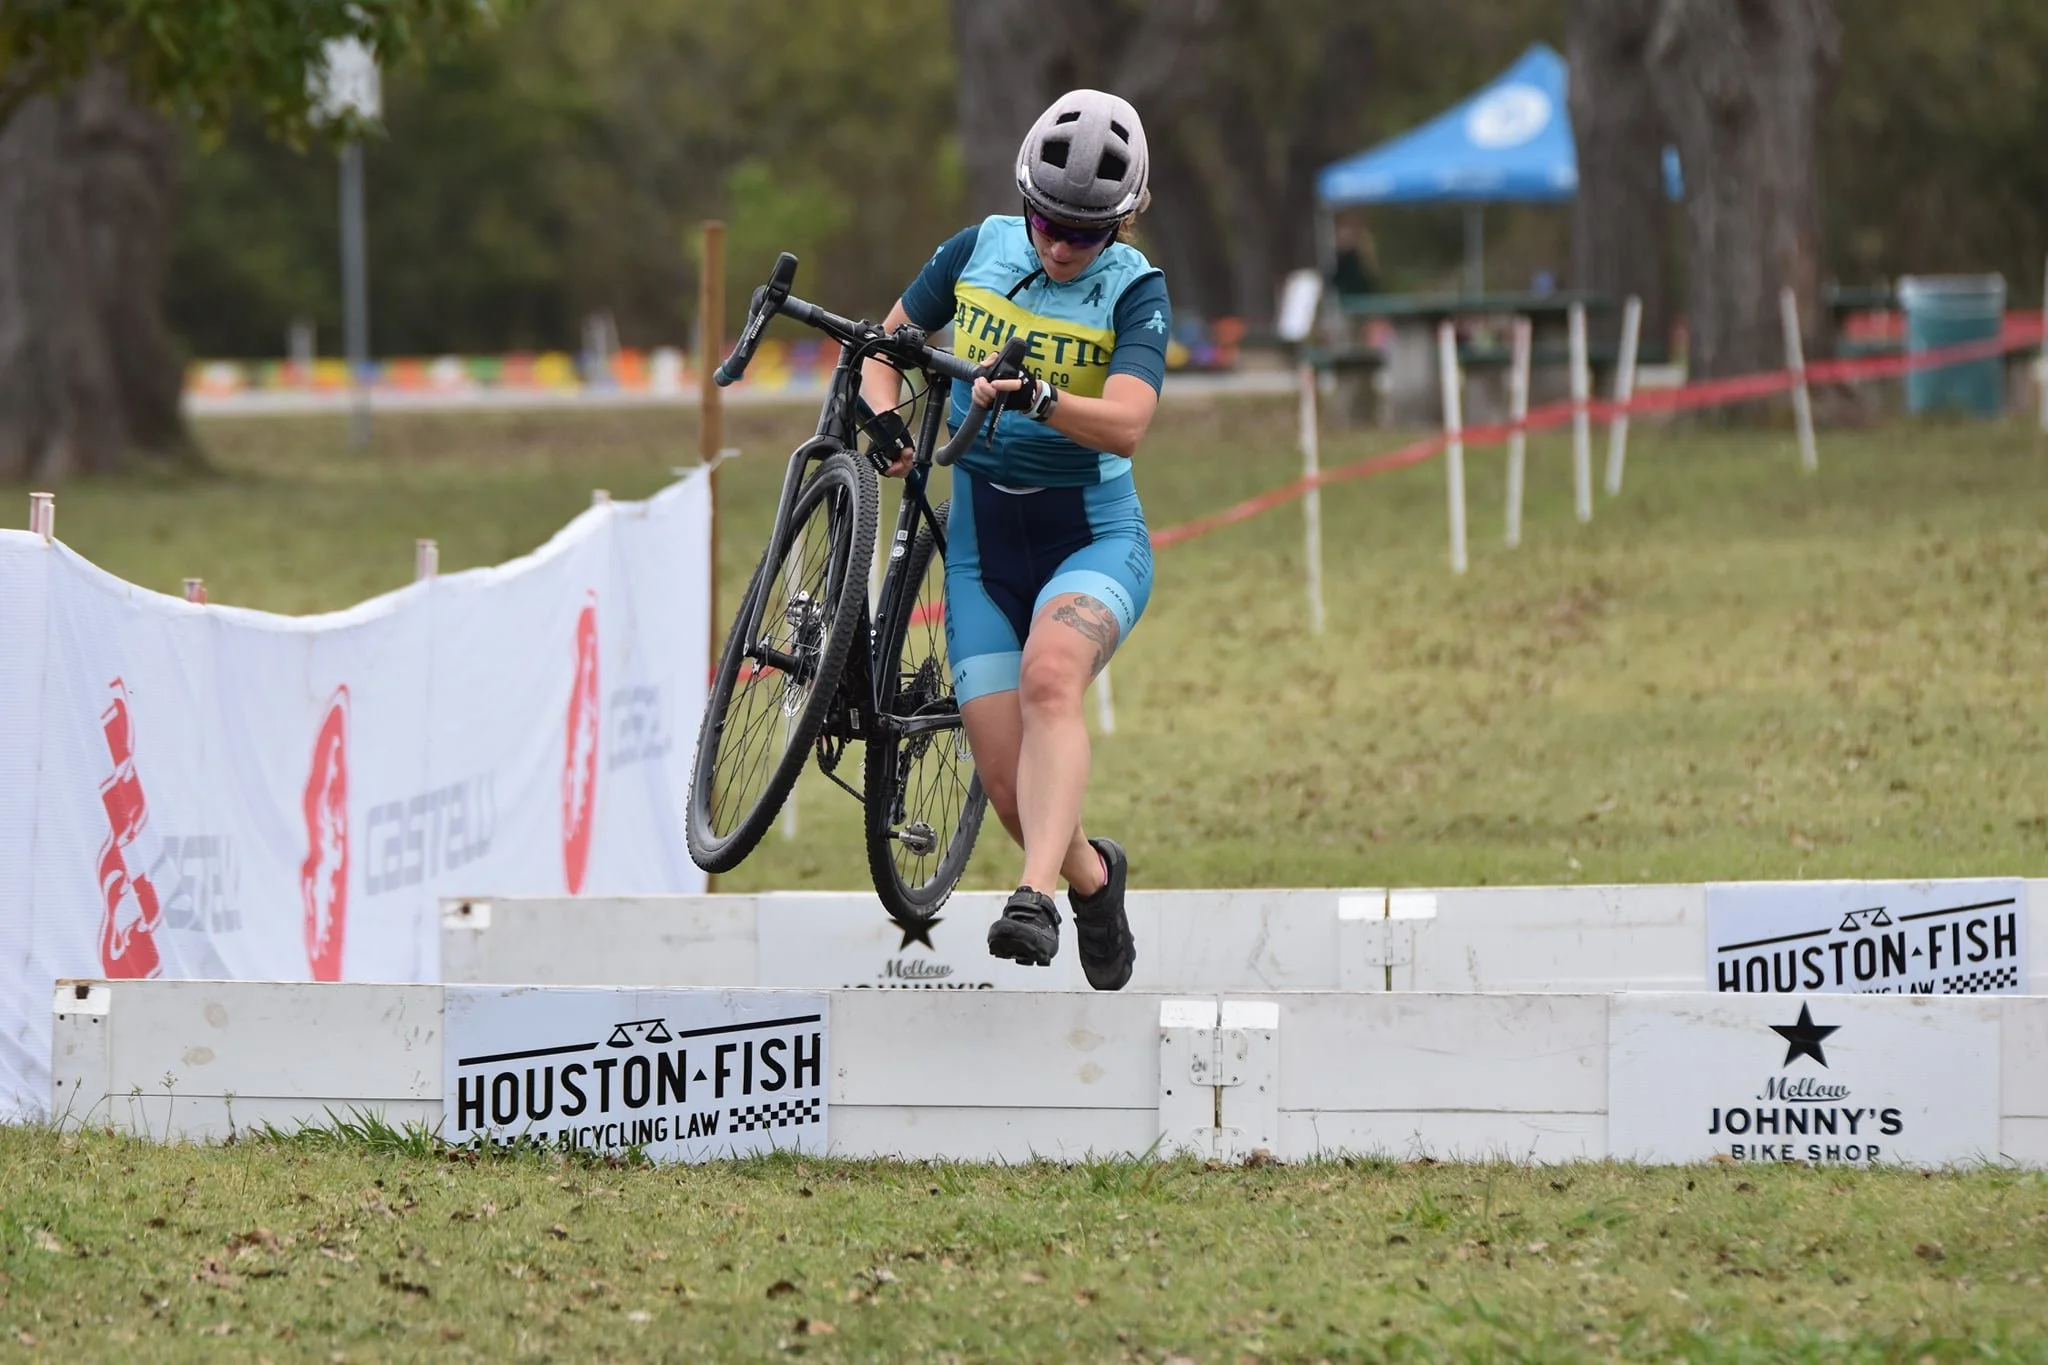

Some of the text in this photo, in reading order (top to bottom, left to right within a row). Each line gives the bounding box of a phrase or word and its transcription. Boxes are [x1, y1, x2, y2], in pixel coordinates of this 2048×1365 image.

[1717, 912, 2017, 993] HOUSTON FISH
[877, 959, 954, 980] Mellow
[457, 1032, 821, 1131] HOUSTON FISH
[1756, 1077, 1851, 1102] Mellow
[558, 1110, 720, 1152] BICYCLING LAW
[1708, 1108, 1903, 1136] JOHNNY'S
[1731, 1144, 1881, 1162] BIKE SHOP
